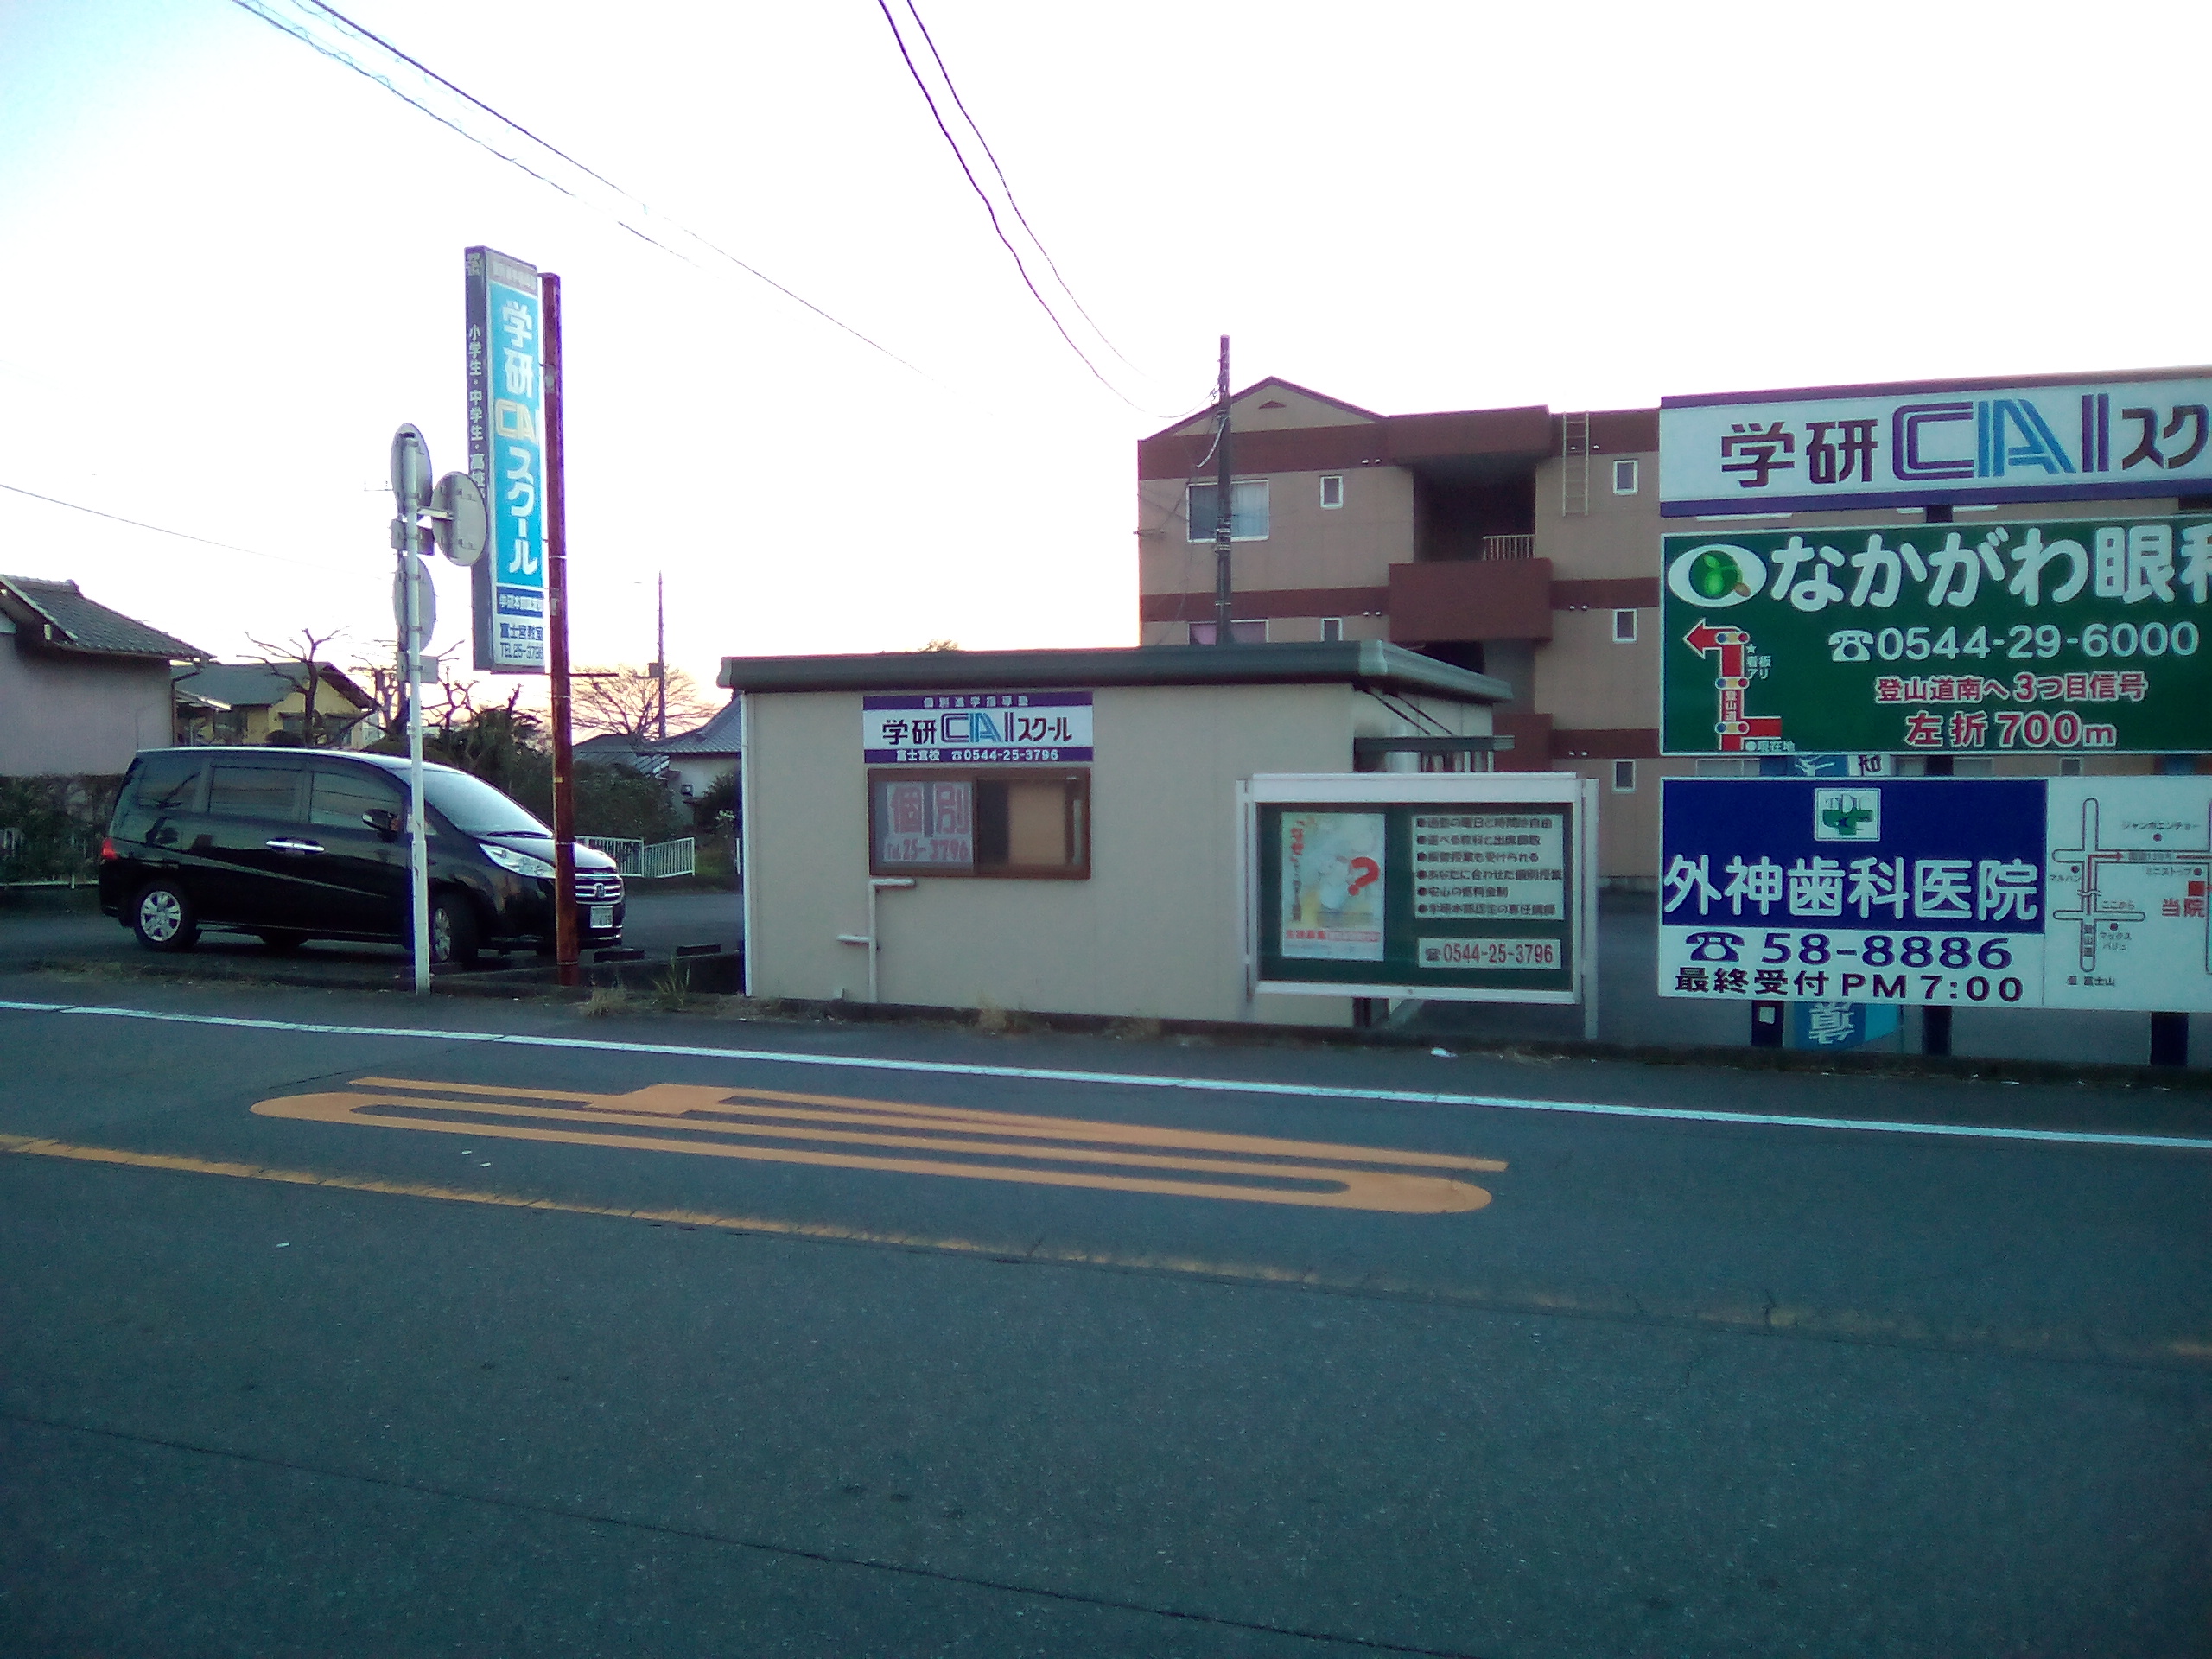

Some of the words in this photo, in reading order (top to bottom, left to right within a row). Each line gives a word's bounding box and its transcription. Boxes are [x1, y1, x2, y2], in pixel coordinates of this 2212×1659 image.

[1720, 393, 2209, 488] 学研CAIスク
[1878, 621, 2200, 661] 0544-29-6000
[1874, 671, 2149, 704] 登山道南へ3つ目信号
[882, 712, 1072, 745] 学研CAIスクール
[964, 749, 1058, 760] 0544-25-3796
[1663, 854, 2038, 921] 外神歯科医院
[2162, 898, 2205, 917] 当院
[1444, 944, 1554, 964] 0544-25-3796
[1761, 931, 2014, 970] 58-8886
